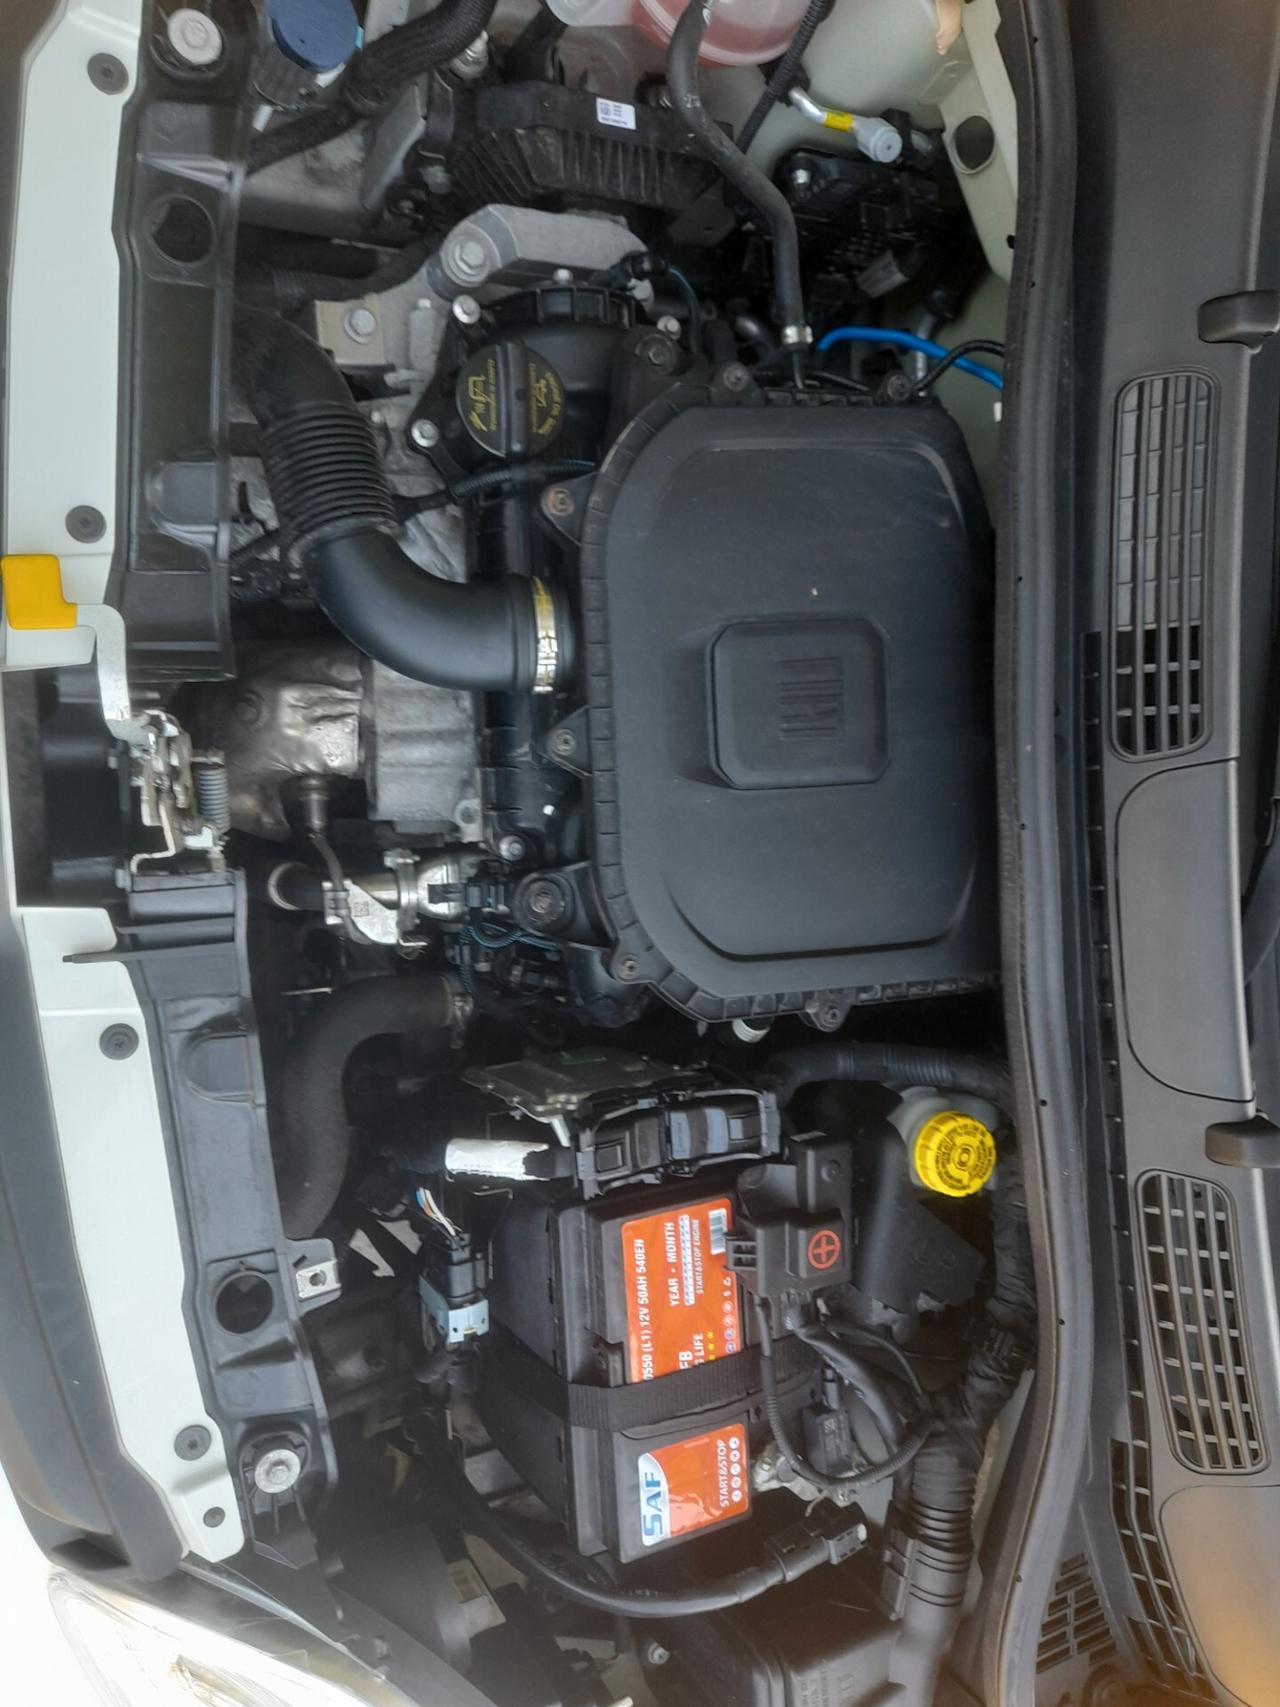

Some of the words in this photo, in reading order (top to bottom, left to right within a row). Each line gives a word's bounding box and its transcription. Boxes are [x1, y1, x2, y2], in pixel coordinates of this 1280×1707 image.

[633, 1239, 647, 1274] 540EN
[664, 1222, 677, 1263] MONTH
[693, 1247, 704, 1294] START&STOP
[636, 1276, 649, 1304] 50AH
[667, 1278, 680, 1306] YEAR
[639, 1307, 651, 1328] 12V
[640, 1329, 654, 1352] (L1)
[693, 1333, 705, 1356] LIFE
[716, 1440, 730, 1508] START&STOP
[643, 1472, 663, 1537] SAF
